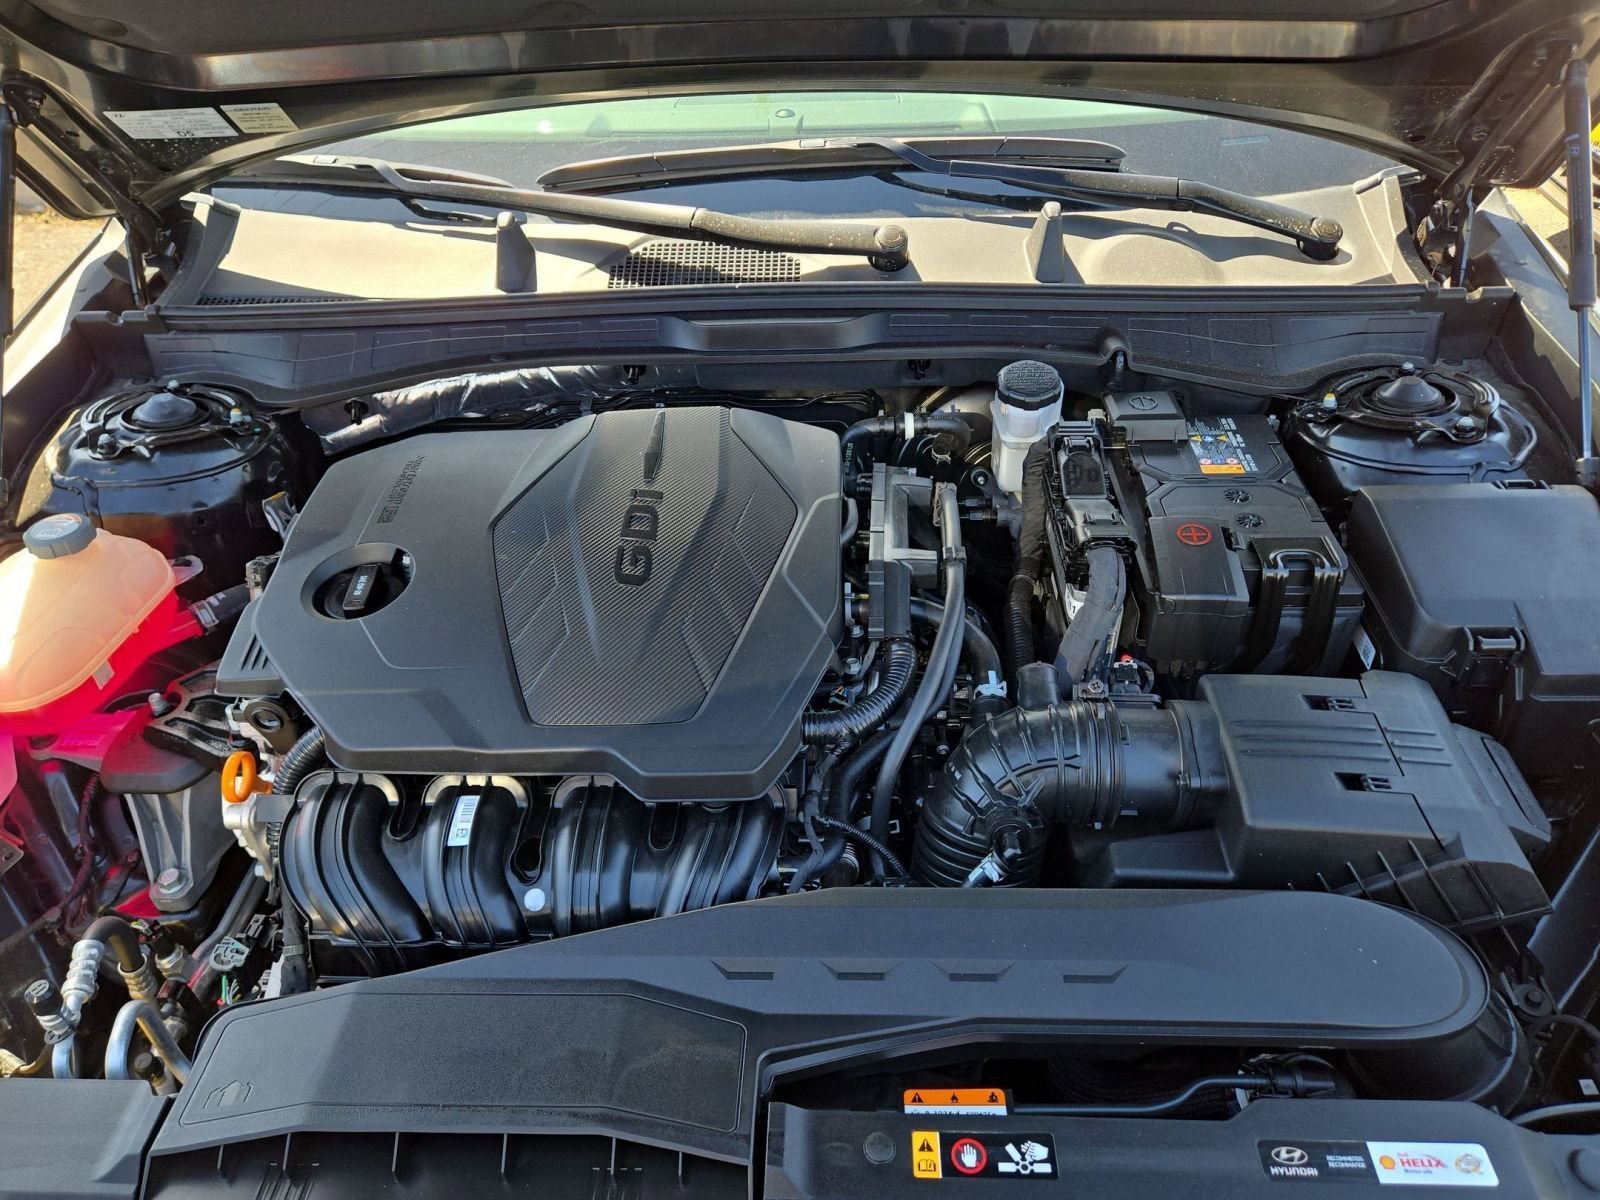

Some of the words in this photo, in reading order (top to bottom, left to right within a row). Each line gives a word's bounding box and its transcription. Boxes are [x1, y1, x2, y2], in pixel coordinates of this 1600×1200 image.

[393, 455, 427, 505] Smartstream
[1400, 1158, 1447, 1168] HELIX
[1270, 1165, 1318, 1177] HYUNDAI
